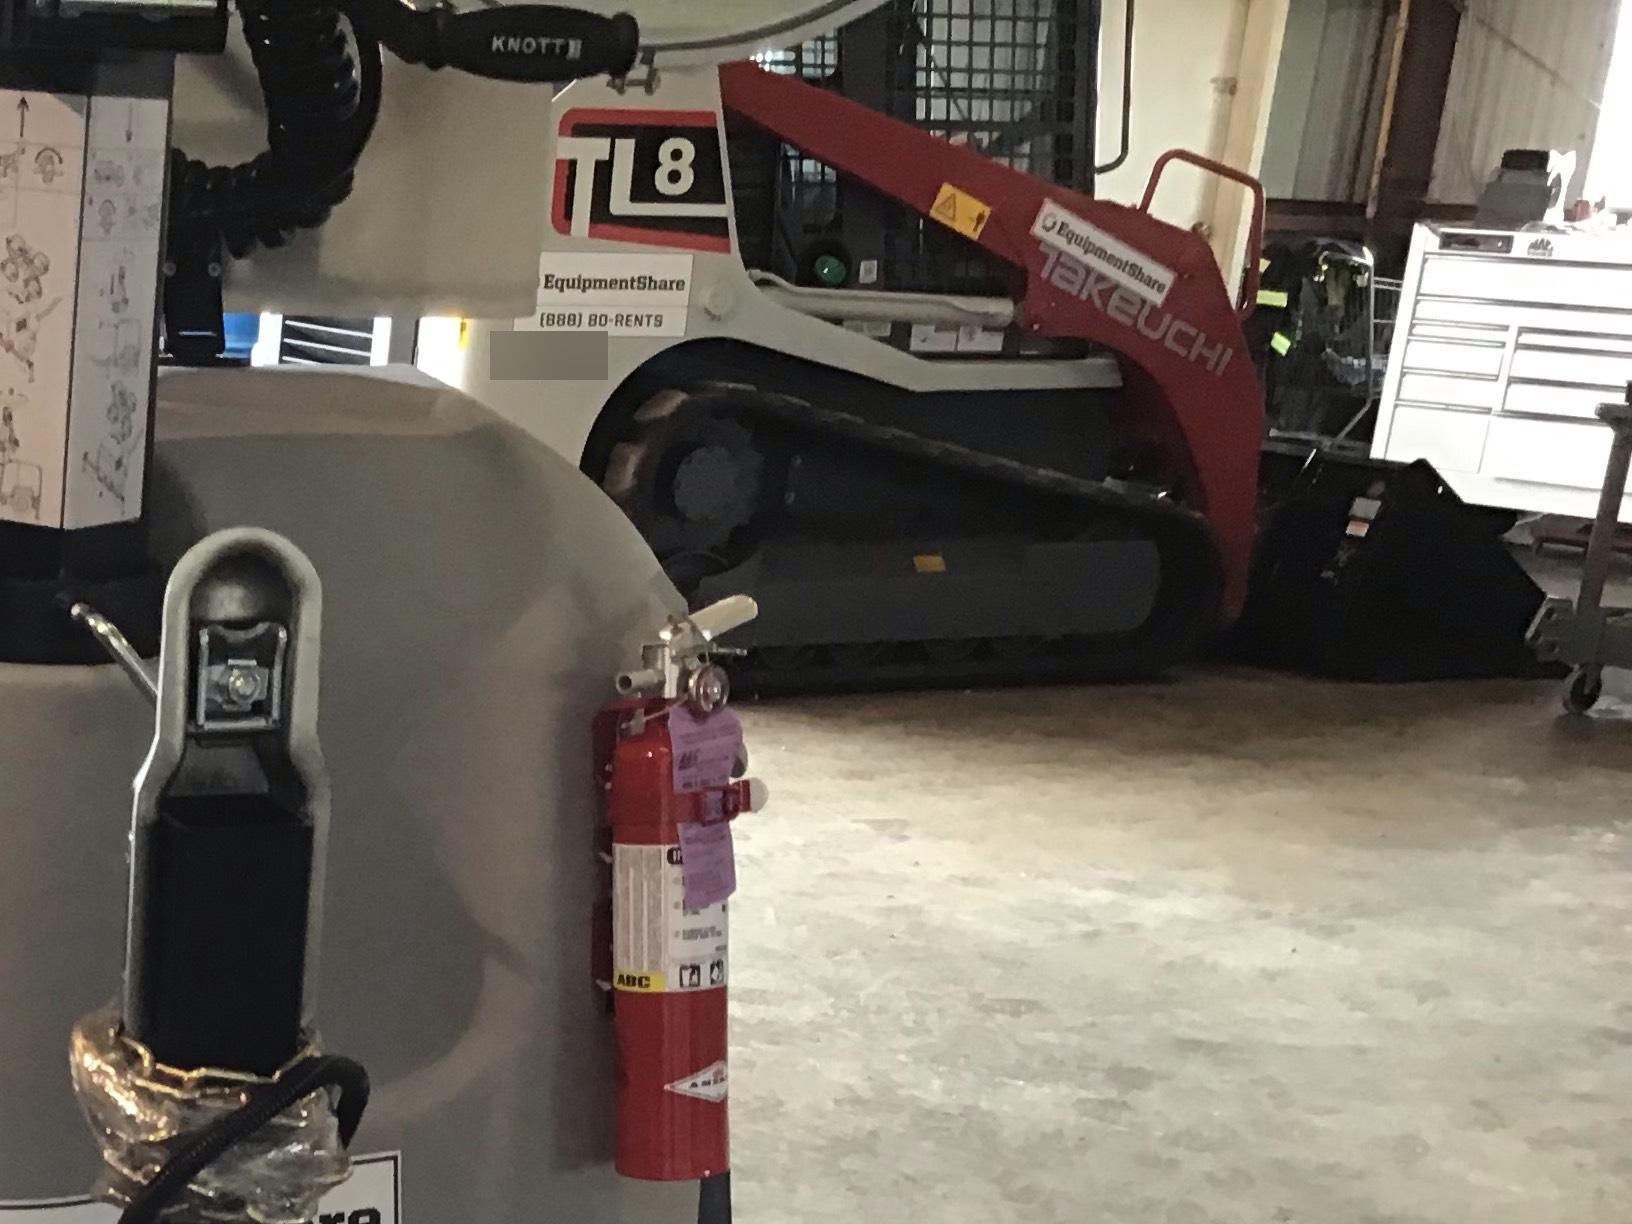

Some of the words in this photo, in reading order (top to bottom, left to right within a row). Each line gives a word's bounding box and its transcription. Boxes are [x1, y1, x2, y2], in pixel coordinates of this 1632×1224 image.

[491, 36, 567, 54] KNOTT
[1056, 219, 1167, 295] EquipmentShare
[543, 273, 686, 293] EquipmentShare
[539, 312, 583, 328] (888)
[587, 312, 664, 328] 80-RENTS
[617, 974, 651, 989] ABC
